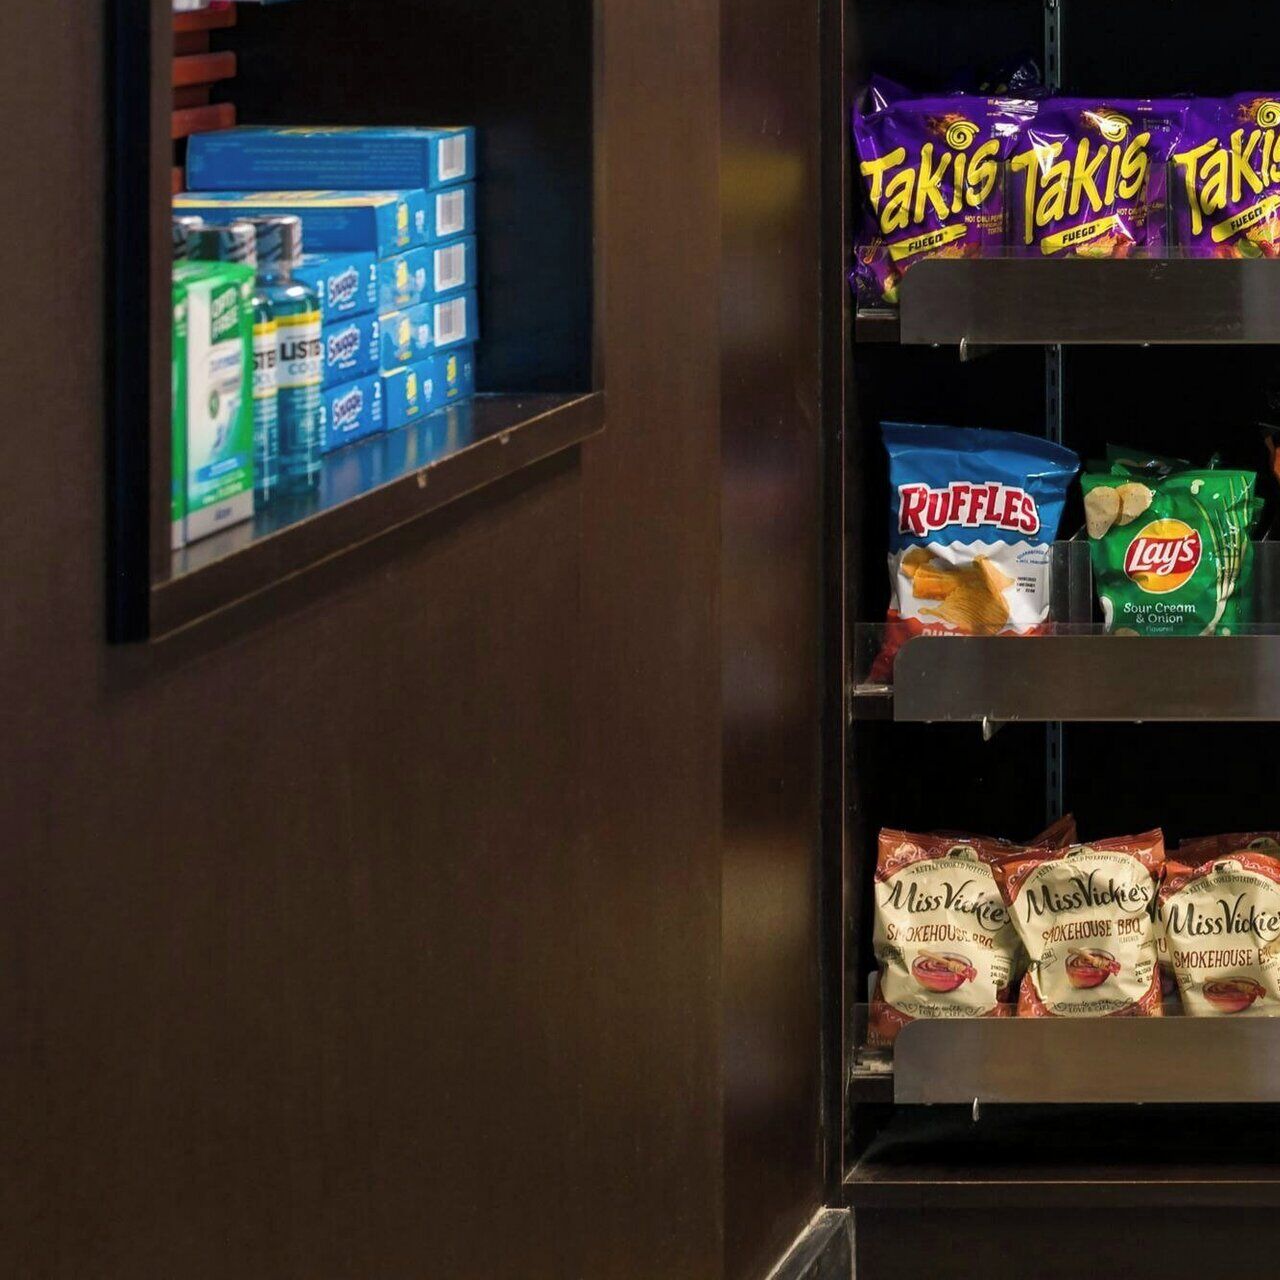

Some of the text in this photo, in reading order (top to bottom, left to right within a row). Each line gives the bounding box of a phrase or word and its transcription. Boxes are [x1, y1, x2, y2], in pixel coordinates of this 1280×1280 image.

[1011, 132, 1151, 245] Takis
[1231, 206, 1263, 231] FUEGO
[907, 234, 944, 253] FUEGO
[1062, 225, 1096, 245] FUEGO
[899, 482, 1041, 536] RUFFLES
[1128, 536, 1198, 574] Lay's
[1123, 602, 1196, 614] Sour Cream
[1136, 612, 1183, 623] & Onion
[881, 880, 943, 914] Miss
[1026, 885, 1081, 923] Miss
[1117, 917, 1145, 935] BBQ
[1166, 903, 1223, 936] Miss
[1174, 949, 1253, 968] SMOKEHOUSE
